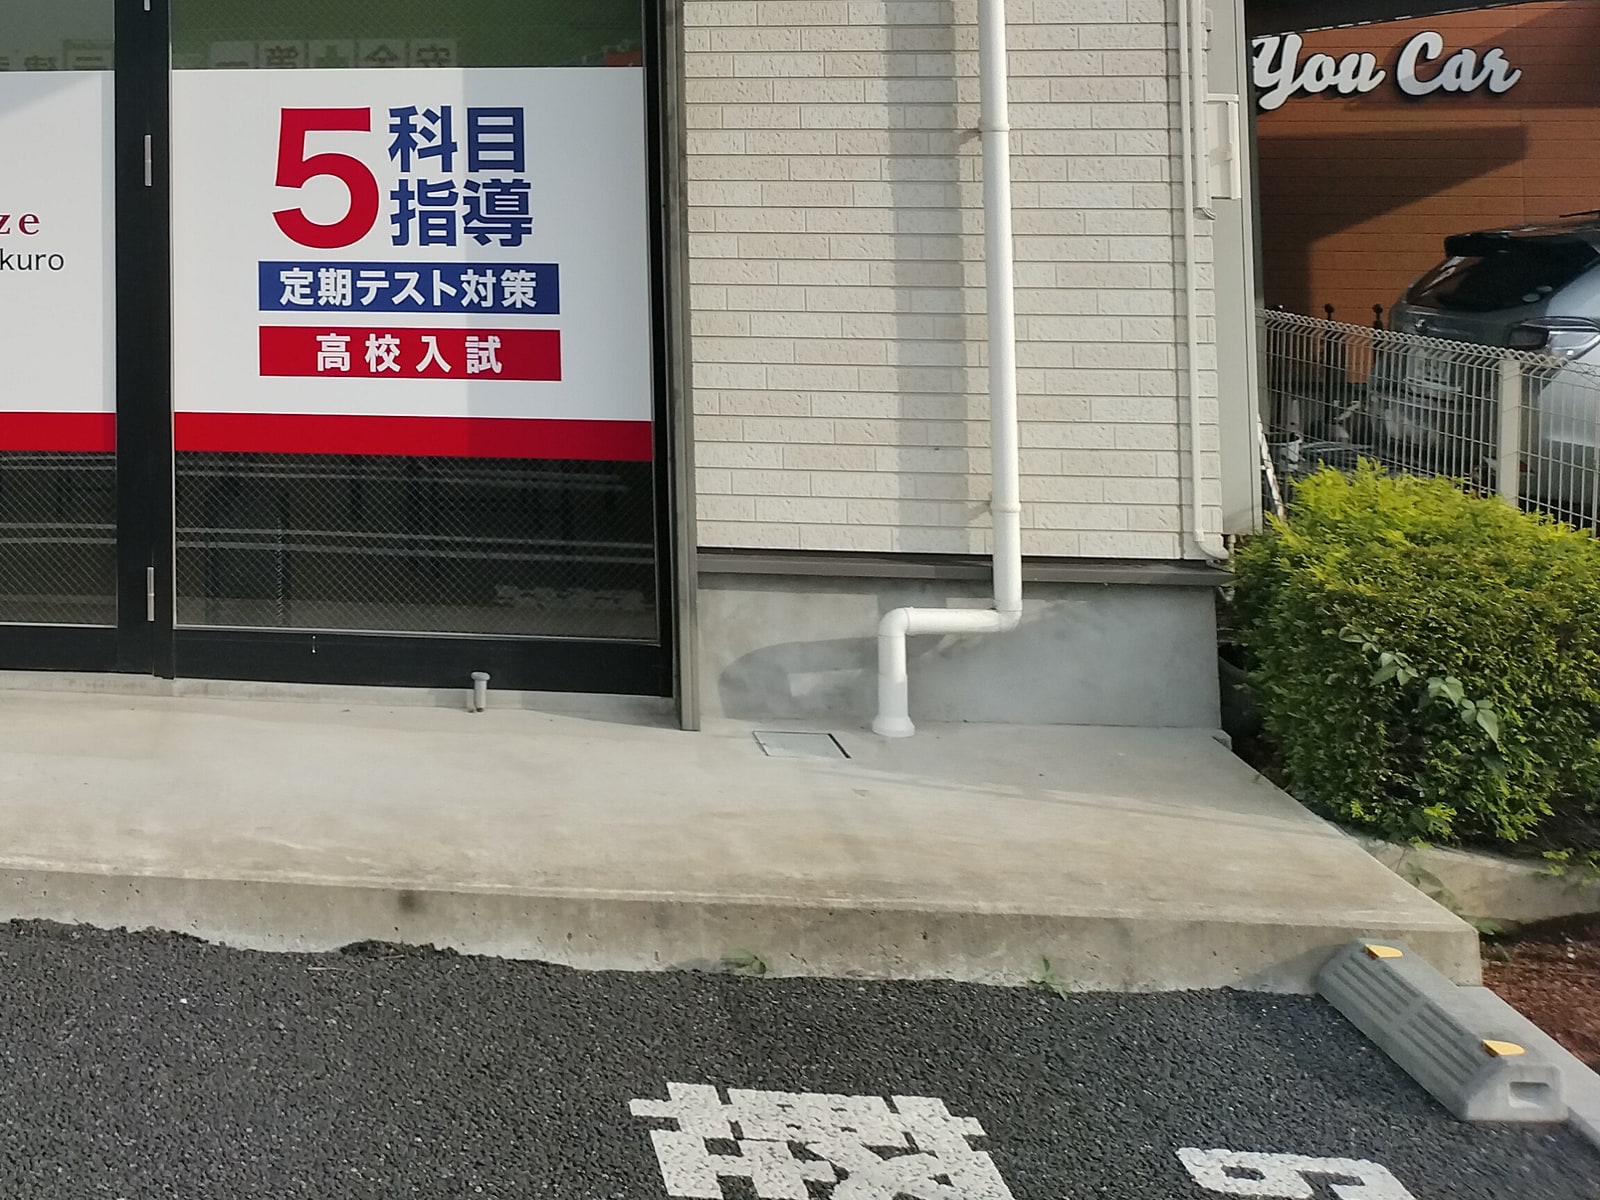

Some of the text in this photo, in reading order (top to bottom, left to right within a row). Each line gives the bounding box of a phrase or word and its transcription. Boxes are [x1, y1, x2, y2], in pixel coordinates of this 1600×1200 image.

[1252, 31, 1521, 110] You Car
[274, 107, 524, 248] 5 科目
[391, 179, 531, 247] 指導
[279, 268, 537, 308] 定期テスト対策
[316, 333, 502, 374] 高校入試
